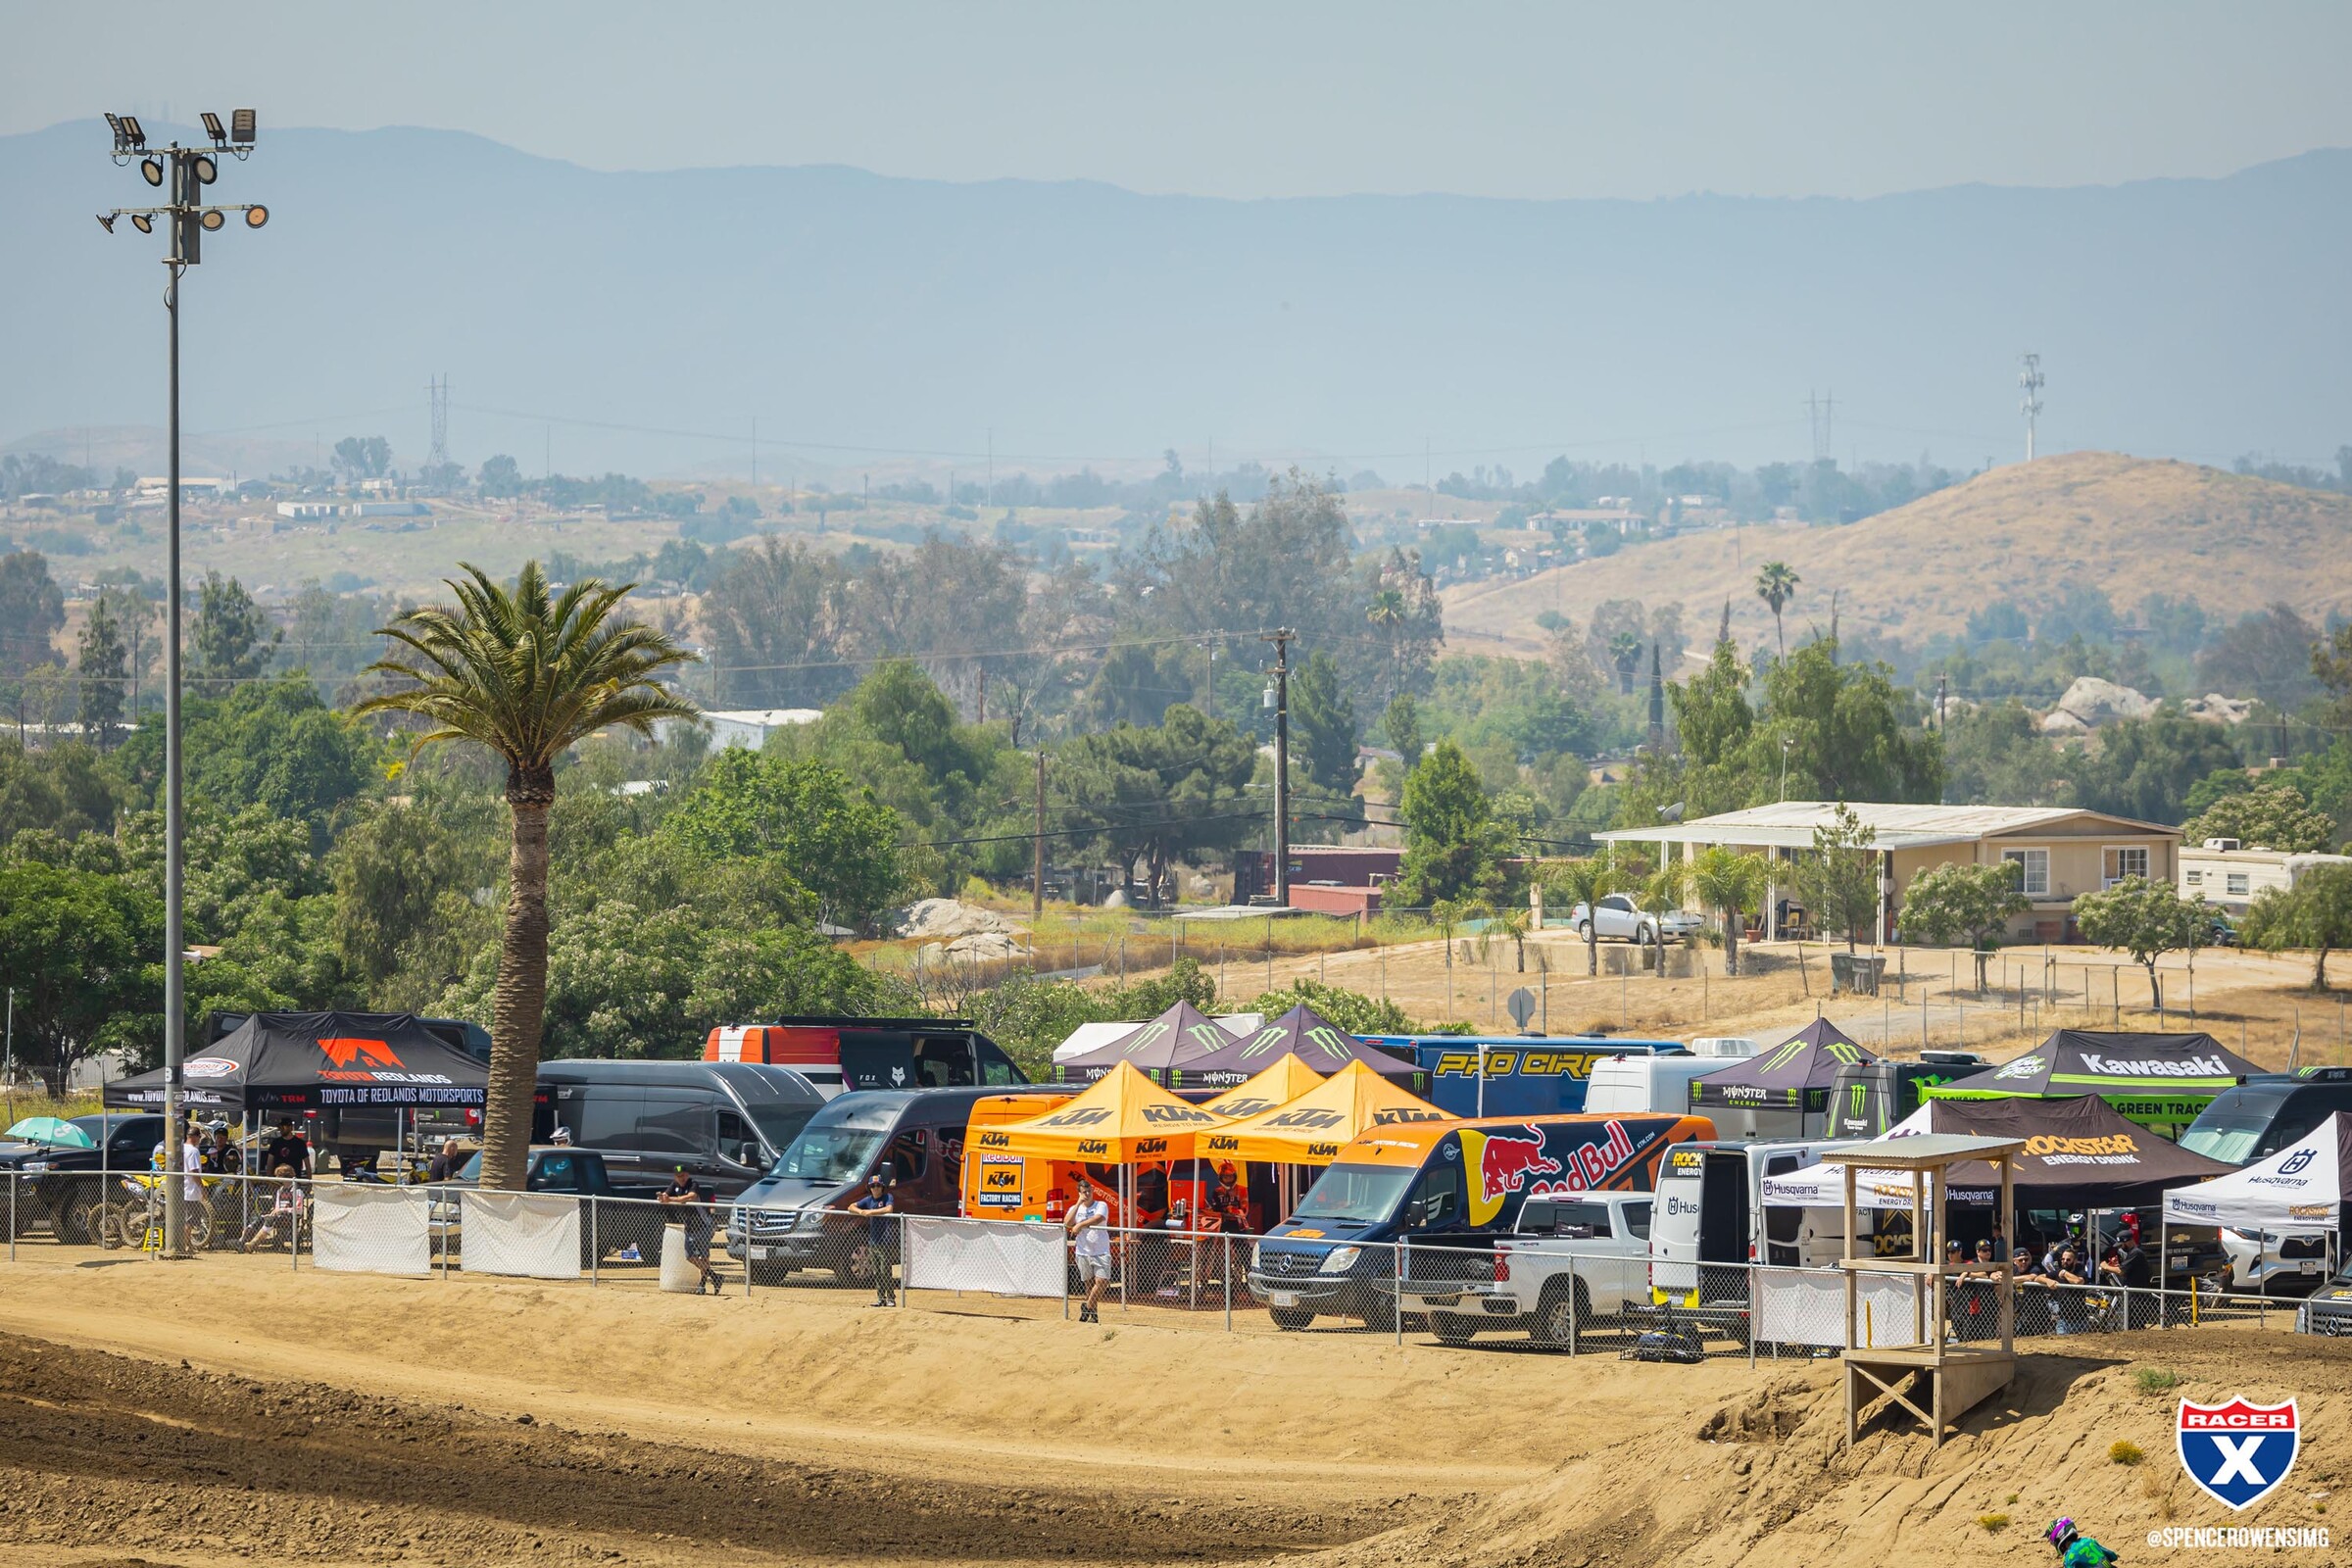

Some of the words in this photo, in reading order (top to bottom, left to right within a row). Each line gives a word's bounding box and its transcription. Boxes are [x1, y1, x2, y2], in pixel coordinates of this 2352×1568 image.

[1435, 1053, 1518, 1079] PRO
[1521, 1053, 1608, 1079] CIRC
[2080, 1054, 2230, 1076] Kawasaki
[318, 1070, 377, 1081] TOYOTA
[373, 1071, 452, 1084] REDLANDS
[1203, 1071, 1249, 1084] MONSTER
[320, 1089, 355, 1103] TOYOTA
[358, 1089, 368, 1102] OF
[371, 1088, 416, 1102] REDLANDS
[419, 1089, 484, 1102] MOTORSPORTS
[1723, 1086, 1767, 1100] MONSTER
[1142, 1104, 1214, 1122] KTM
[2117, 1103, 2163, 1114] GREEN
[1037, 1107, 1114, 1126] KTM
[1262, 1108, 1346, 1128] KTM
[1373, 1108, 1443, 1125] KTM
[980, 1132, 1009, 1146] KTM
[1078, 1139, 1107, 1153] KTM
[1136, 1138, 1167, 1153] KTM
[1208, 1136, 1239, 1151] KTM
[1307, 1142, 1338, 1155] KTM
[1577, 1120, 1635, 1186] Bull
[2041, 1154, 2097, 1165] ENERGY
[2096, 1154, 2140, 1164] DRINK
[987, 1171, 1015, 1185] KTM
[2247, 1176, 2308, 1187] Husqvarna
[1774, 1184, 1818, 1196] Husqvarna
[1949, 1189, 1994, 1201] Husqvarna
[981, 1194, 1001, 1202] FACTORY
[2181, 1201, 2216, 1211] Husqvarna
[2289, 1205, 2329, 1216] ROCKSTAR
[1204, 1218, 1219, 1228] 7
